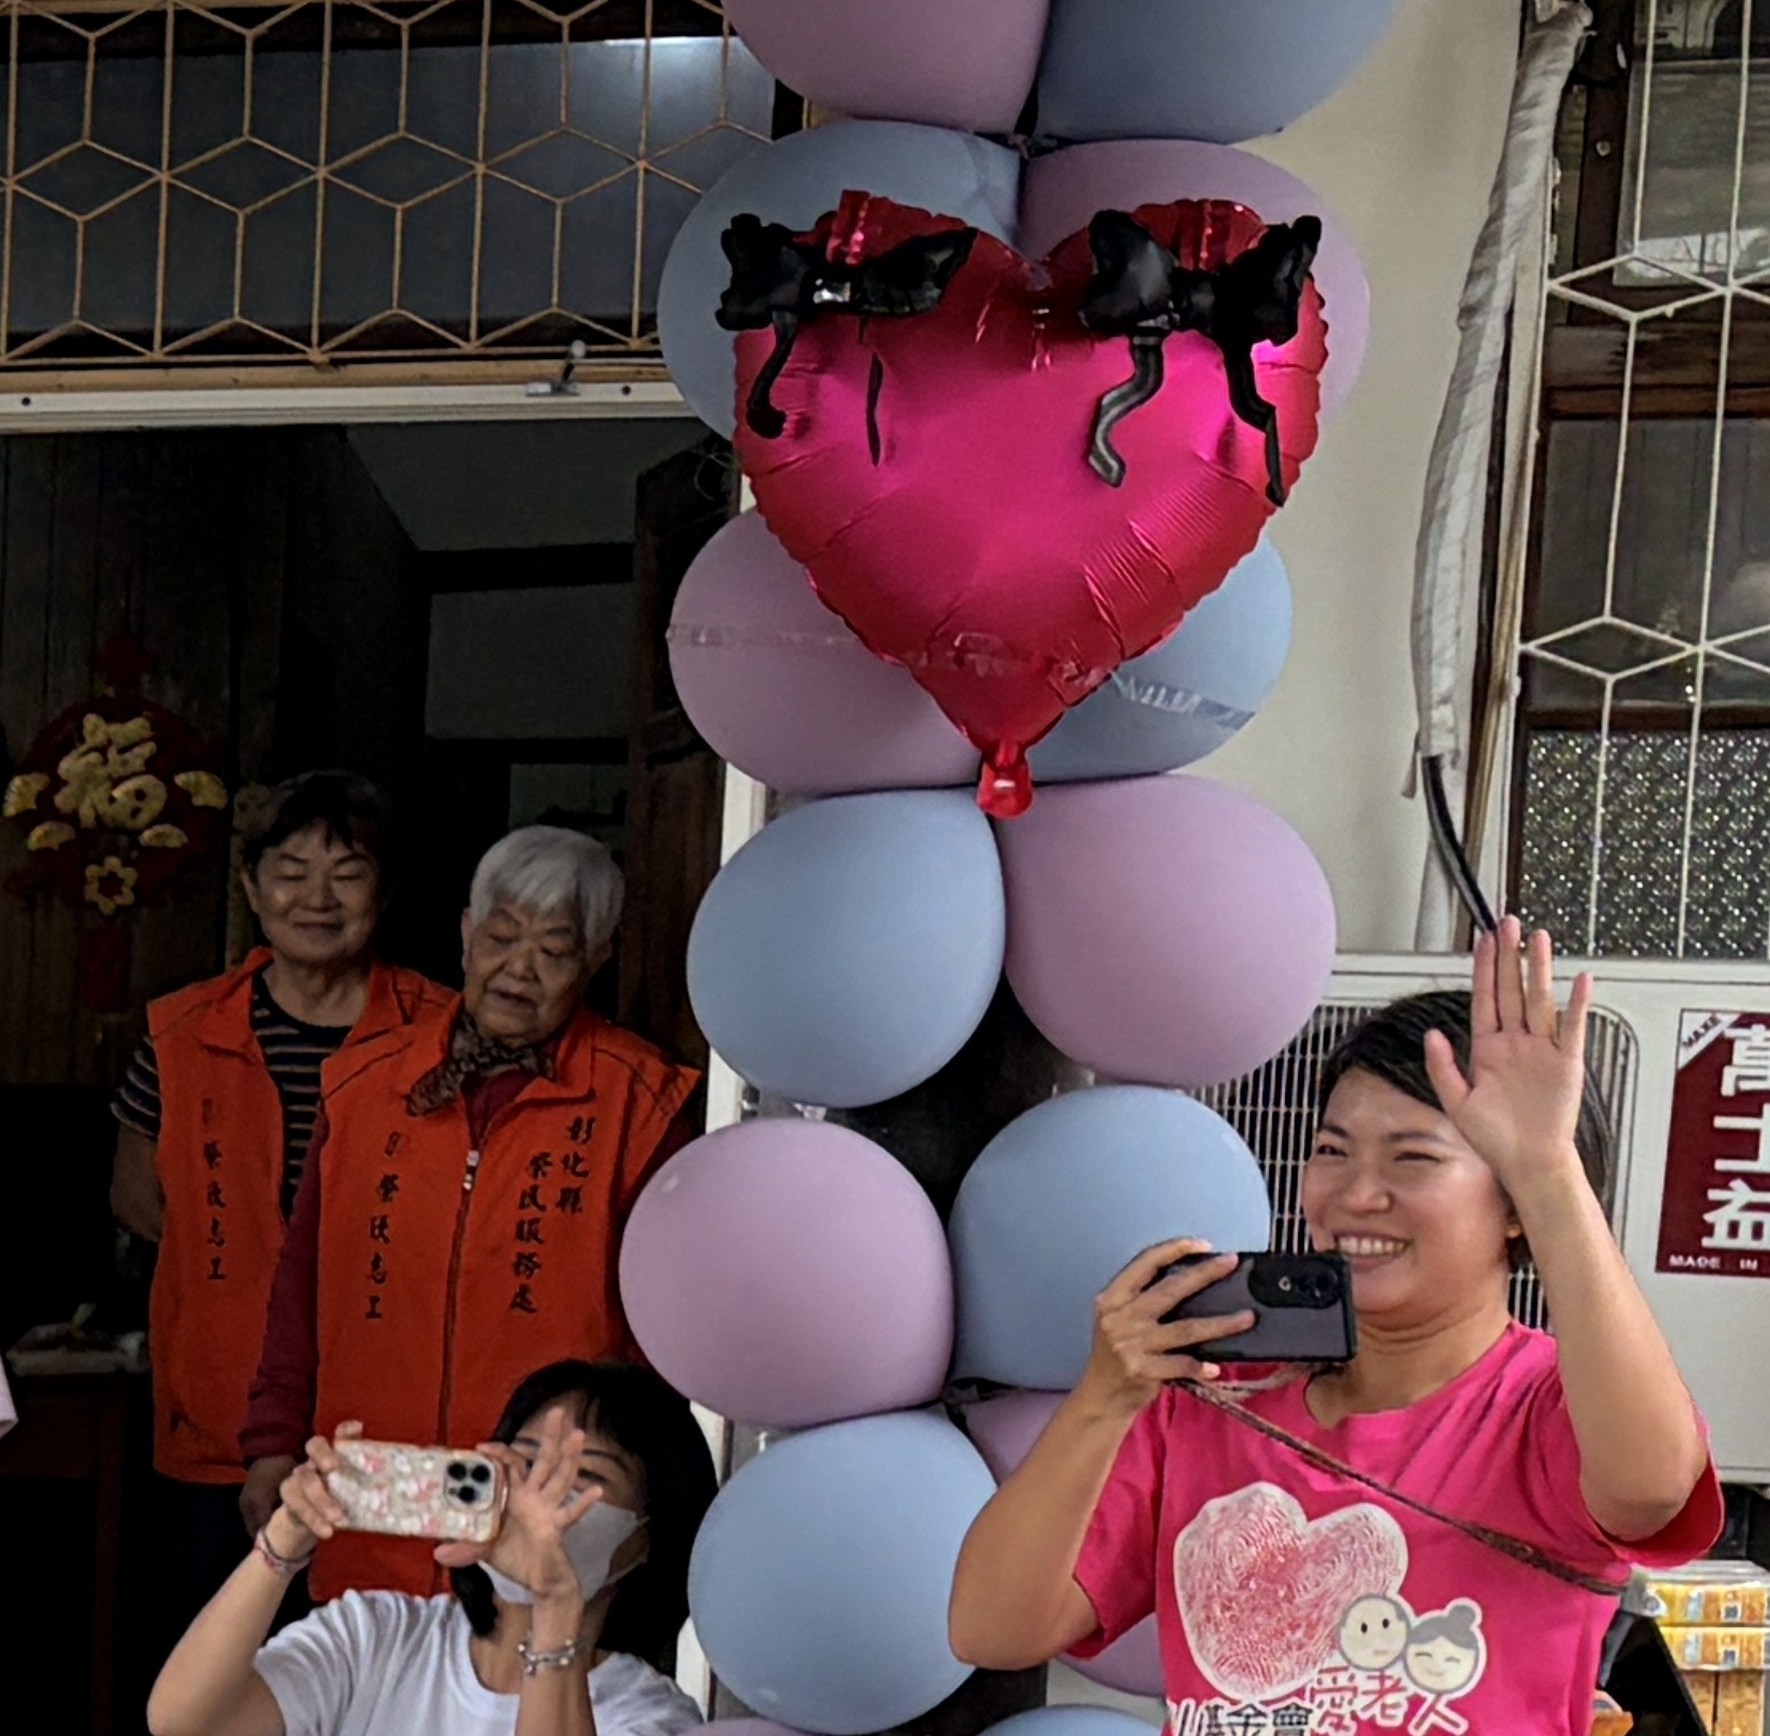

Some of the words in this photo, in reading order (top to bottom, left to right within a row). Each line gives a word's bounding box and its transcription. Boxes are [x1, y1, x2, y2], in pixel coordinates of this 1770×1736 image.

[1668, 1253, 1721, 1270] MADE
[1739, 1257, 1759, 1272] IN
[1310, 1664, 1464, 1736] 愛老人
